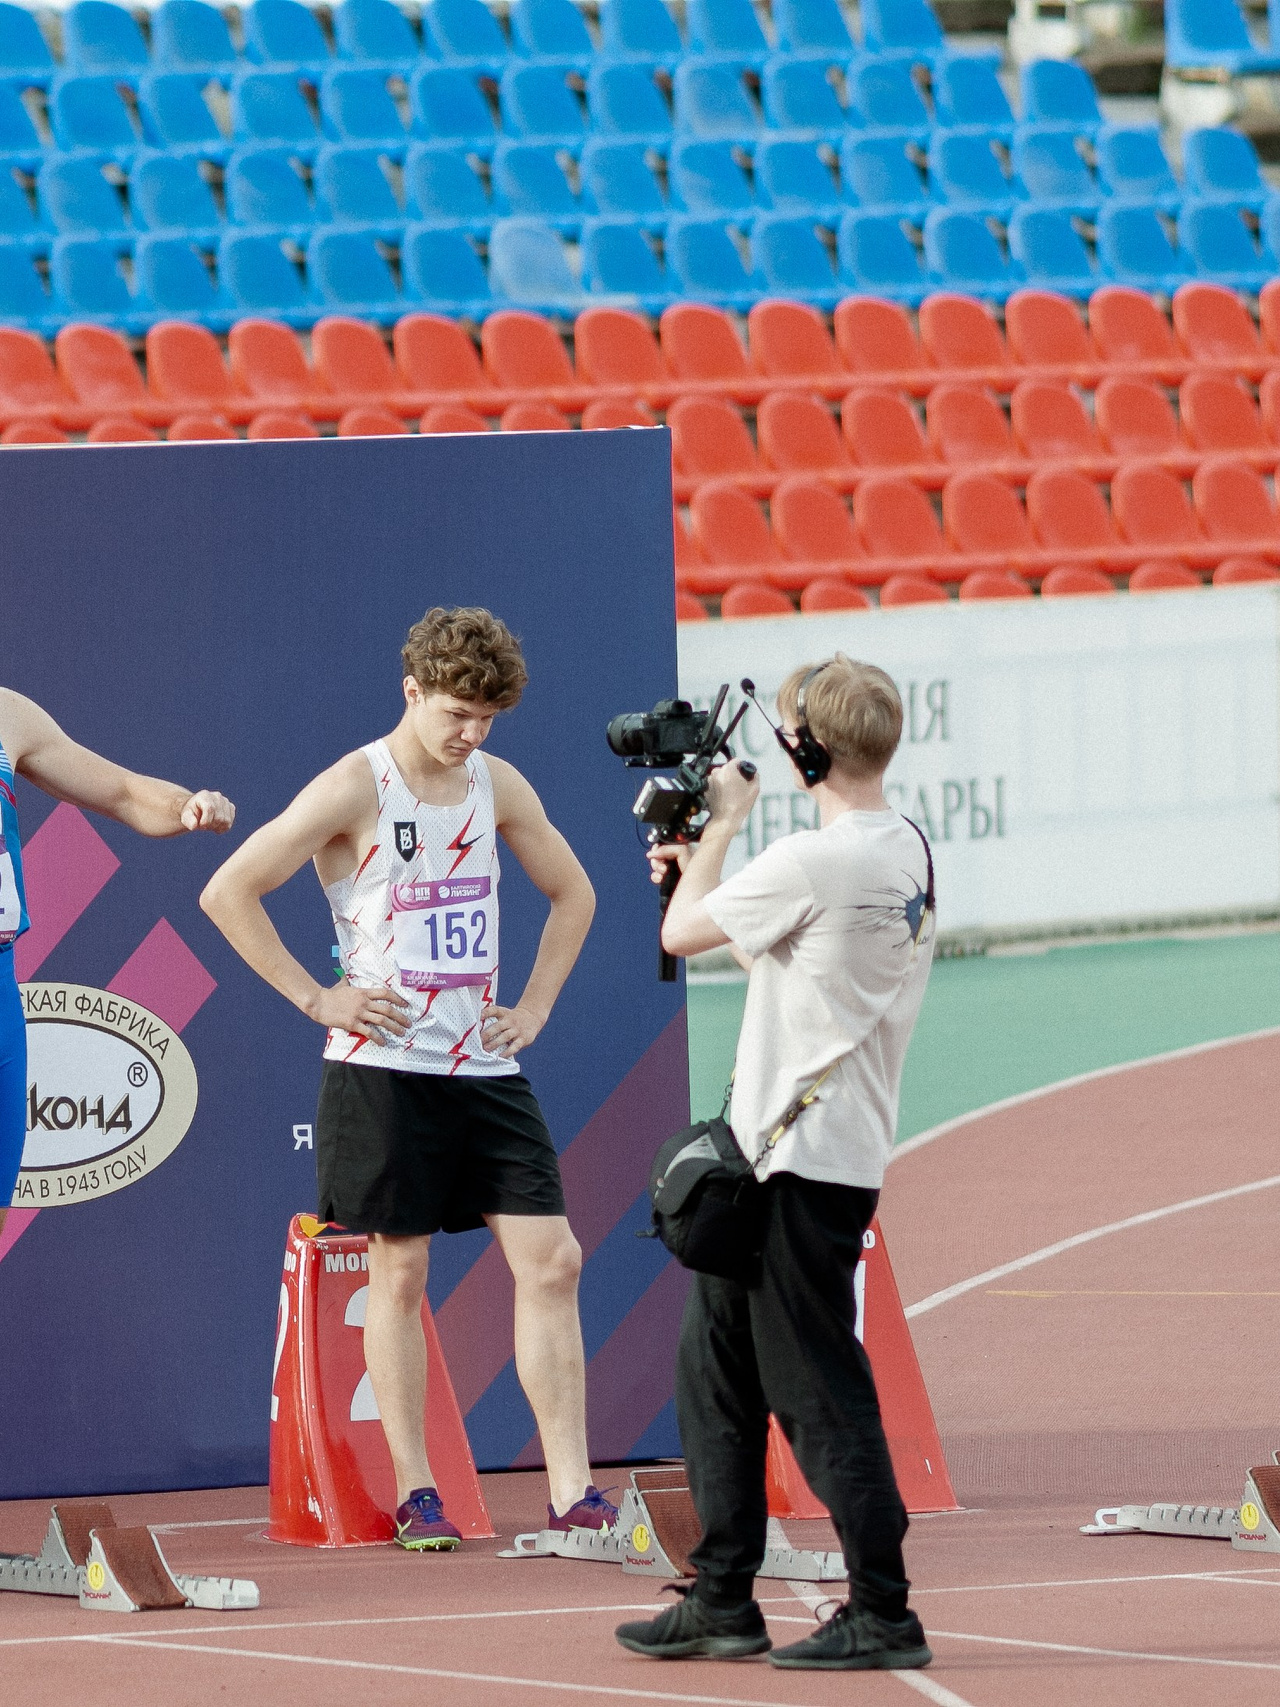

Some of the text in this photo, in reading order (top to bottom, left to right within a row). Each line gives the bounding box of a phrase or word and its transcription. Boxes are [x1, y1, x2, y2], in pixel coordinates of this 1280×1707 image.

[424, 909, 488, 961] 152
[20, 988, 170, 1060] КАЯ ФАБРИКА
[40, 1179, 50, 1198] В
[57, 1171, 100, 1197] 1943
[103, 1145, 147, 1184] ГОДУ
